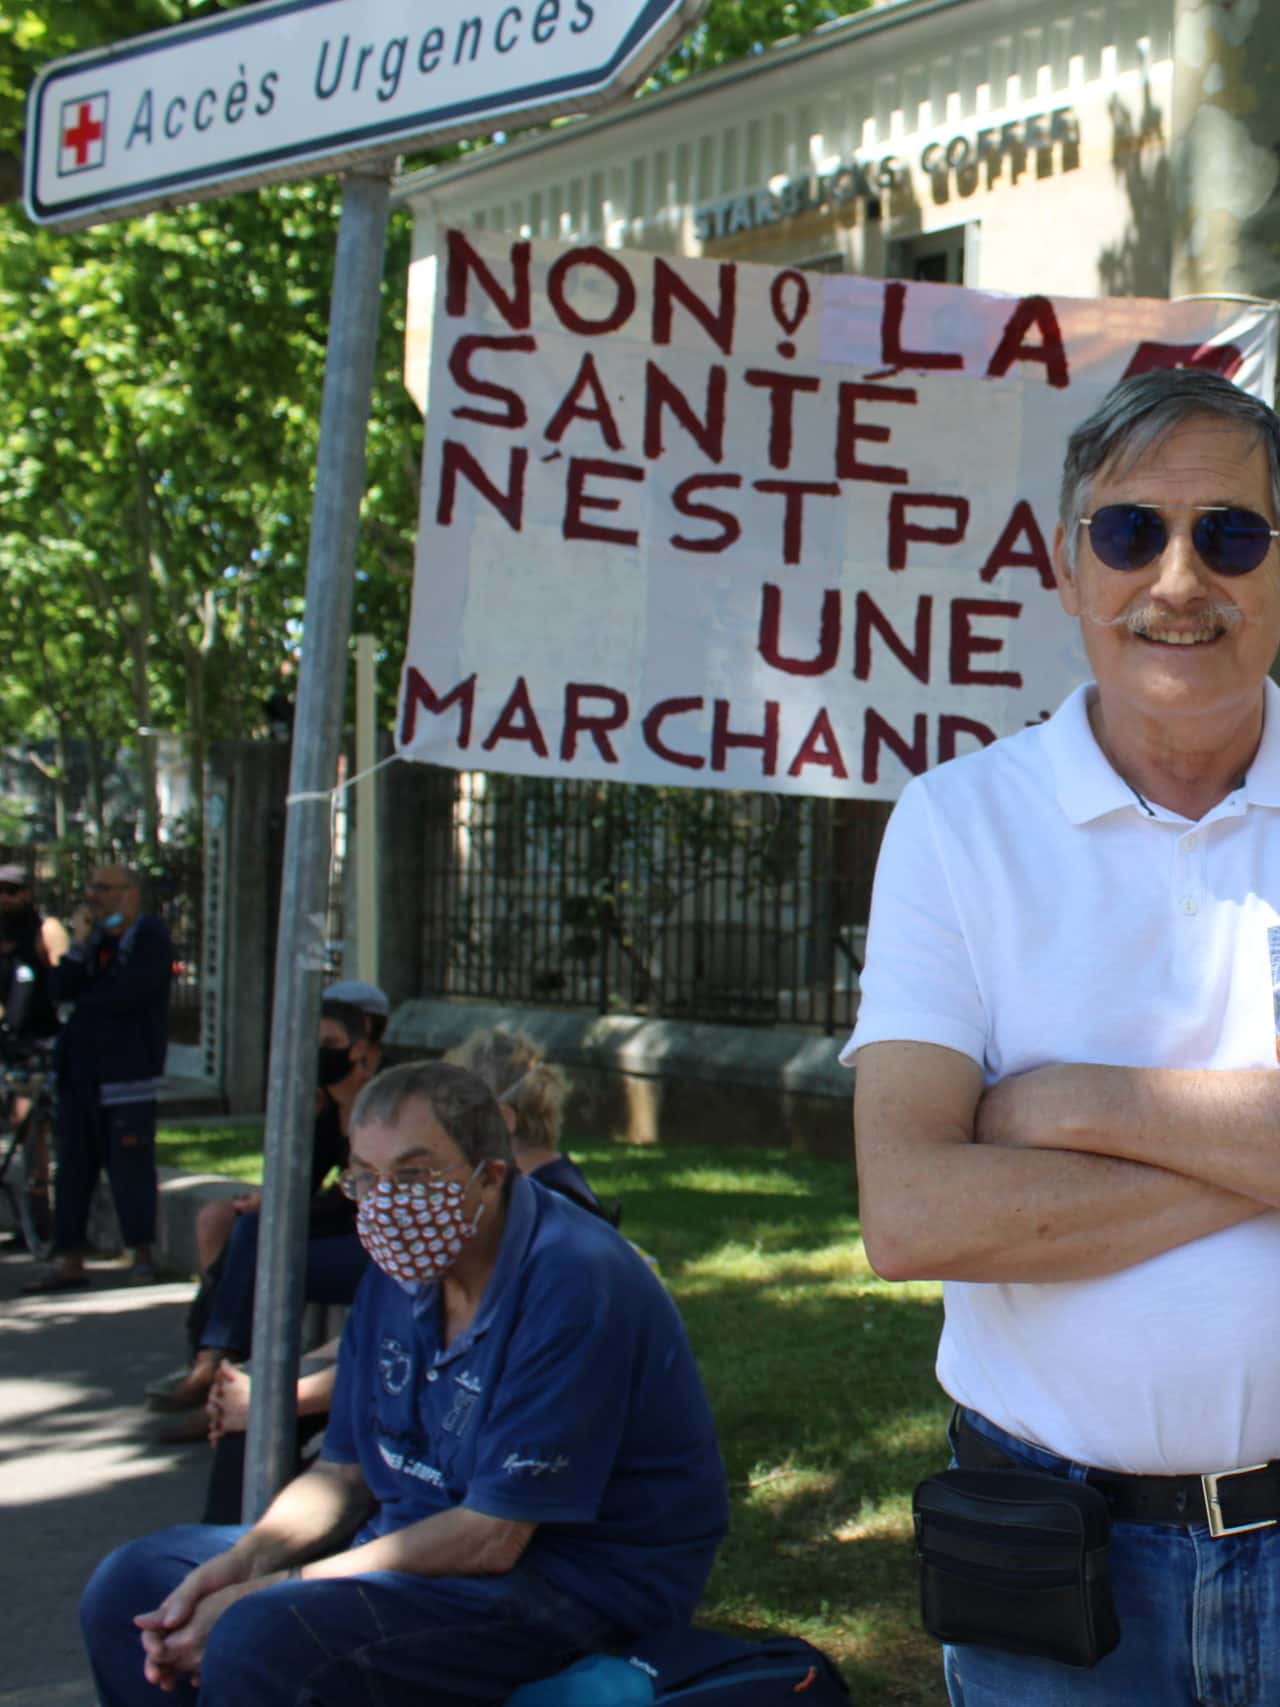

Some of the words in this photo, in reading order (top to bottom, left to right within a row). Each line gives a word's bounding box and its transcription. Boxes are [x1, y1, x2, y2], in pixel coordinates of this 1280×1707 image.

[124, 63, 278, 151] Accès
[315, 0, 594, 102] Urgences
[880, 283, 1070, 390] LA
[448, 335, 918, 485] SANTÉ
[436, 439, 842, 566] N'EST
[757, 582, 1024, 690] UNE
[401, 667, 1050, 778] MARCHAND
